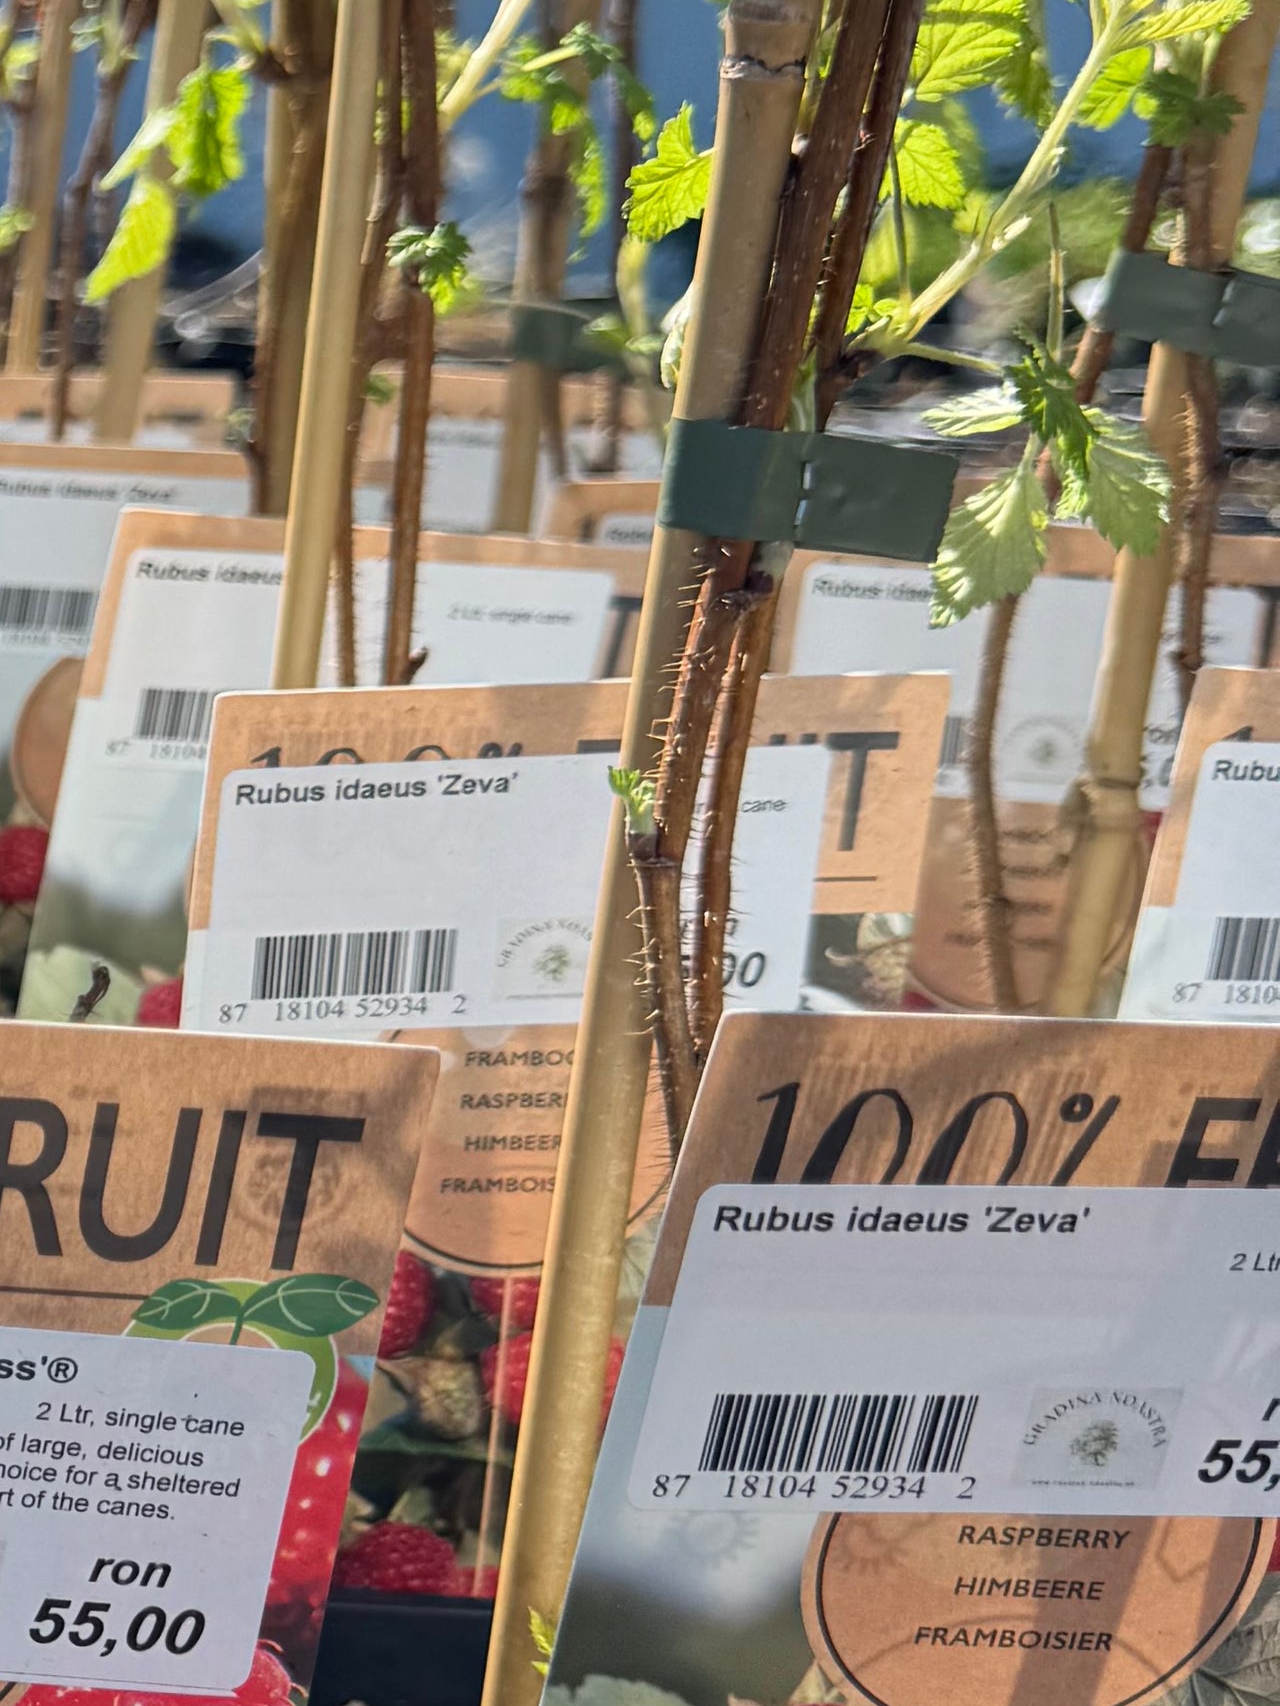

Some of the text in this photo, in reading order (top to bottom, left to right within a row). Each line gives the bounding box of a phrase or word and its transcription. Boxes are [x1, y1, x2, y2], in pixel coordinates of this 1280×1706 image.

[236, 783, 325, 805] Rubus
[336, 779, 427, 800] idaeus
[219, 995, 467, 1024] 87 18104 52934 2
[714, 1206, 834, 1232] Rubus
[847, 1206, 969, 1232] idaeus
[36, 1402, 244, 1436] 2 Ltr, single cane
[21, 1434, 86, 1460] large,
[97, 1441, 203, 1467] delicious
[1197, 1439, 1280, 1492] 55,
[653, 1475, 976, 1499] 87 18104 52934 2
[958, 1525, 1130, 1549] RASPBERRY
[89, 1559, 171, 1588] ron
[954, 1577, 1104, 1600] HIMBEERE
[29, 1598, 205, 1657] 55,00
[914, 1627, 1112, 1651] FRAMBOISIER
